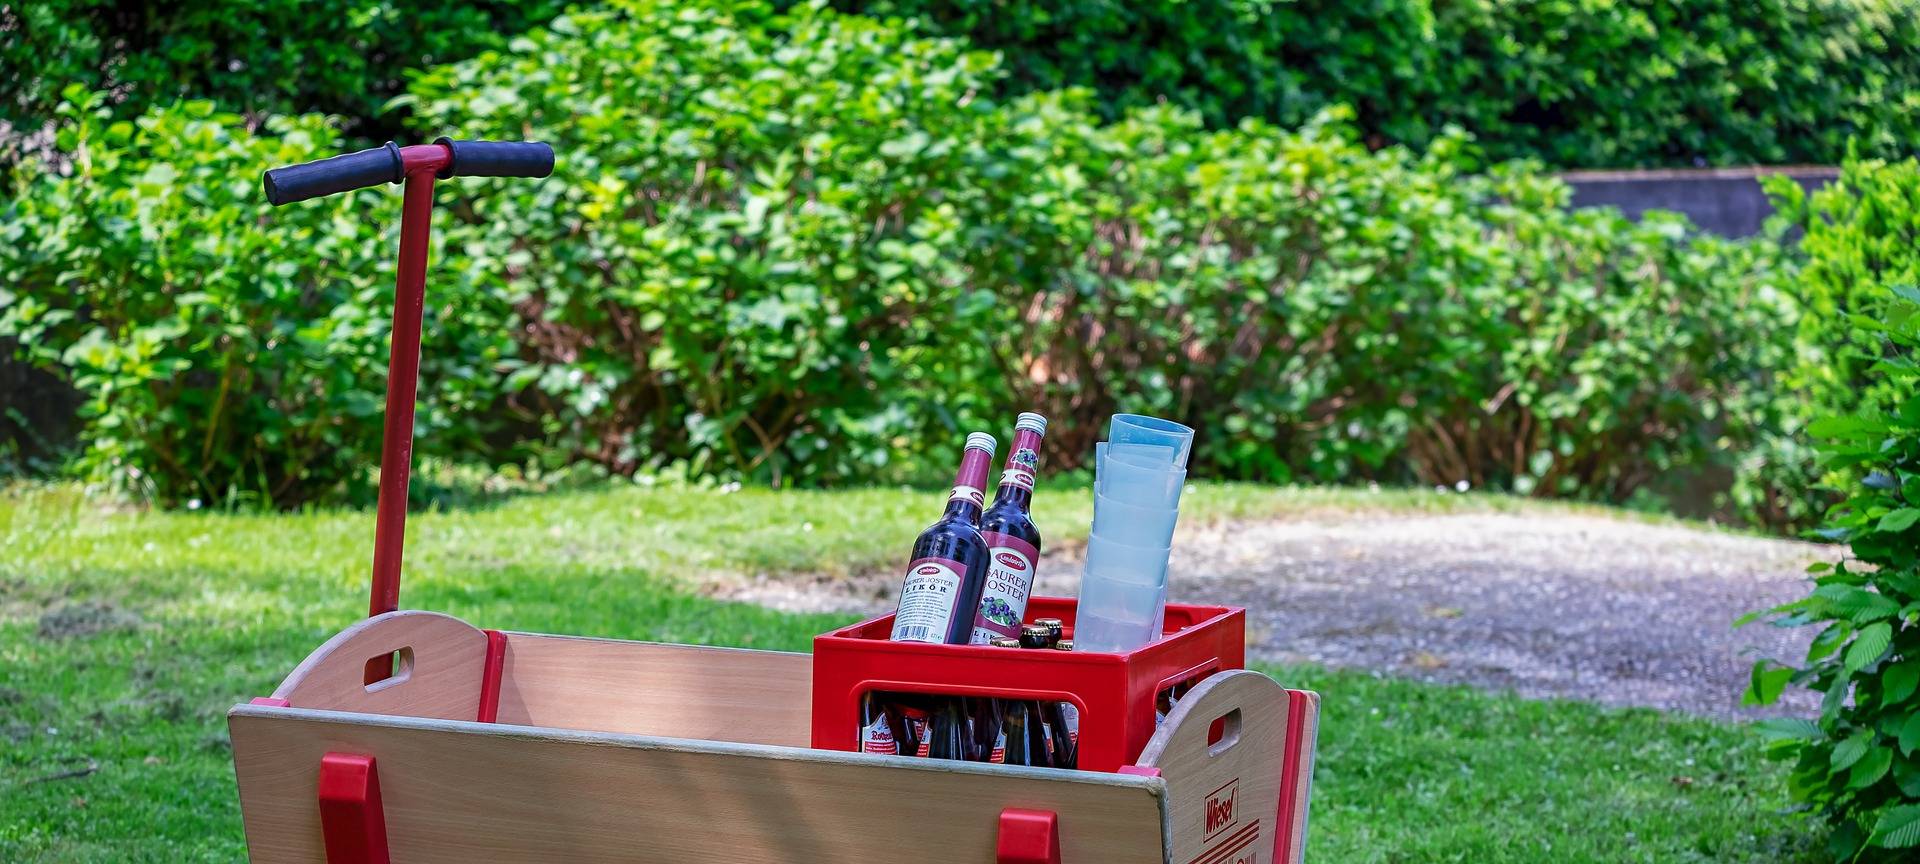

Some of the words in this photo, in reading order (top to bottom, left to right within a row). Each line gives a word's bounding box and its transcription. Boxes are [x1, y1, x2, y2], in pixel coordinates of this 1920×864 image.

[905, 583, 947, 594] LIKÖR
[988, 580, 1024, 602] OSTER
[974, 630, 996, 640] LIK
[1206, 787, 1236, 835] Wiesel
